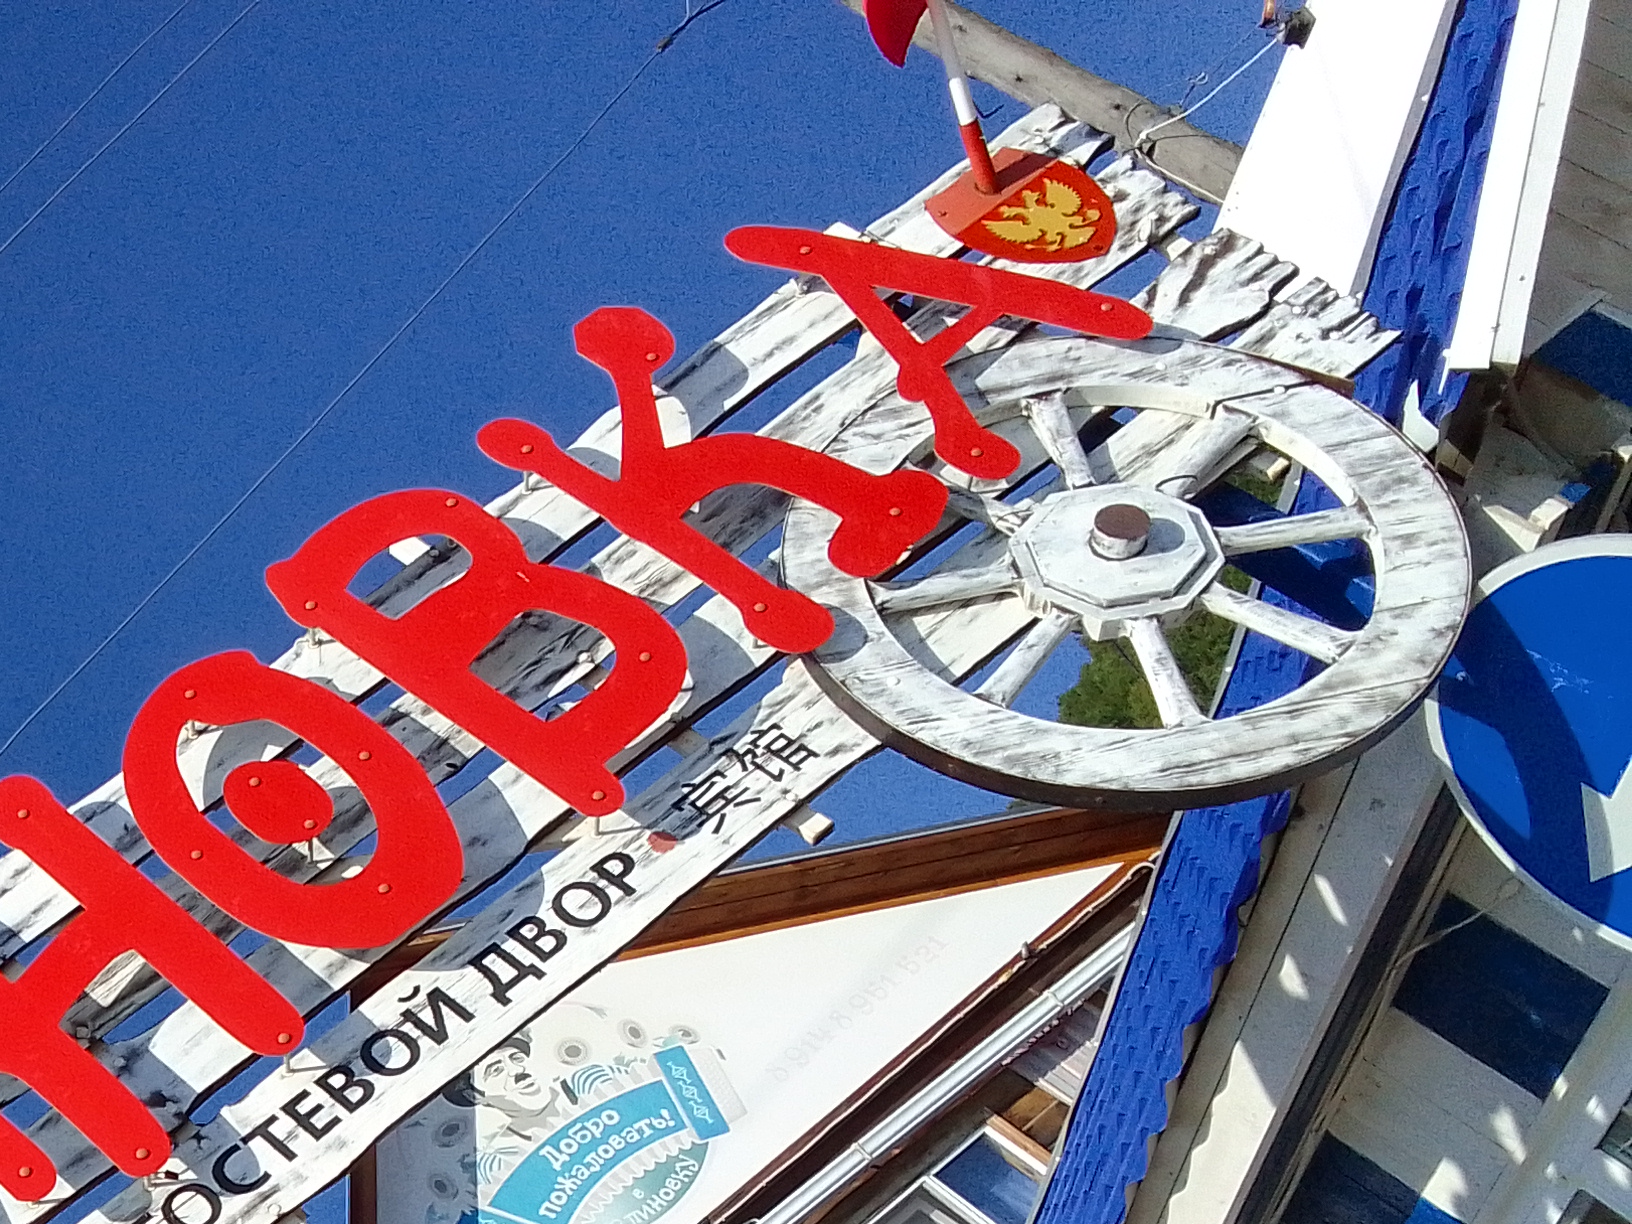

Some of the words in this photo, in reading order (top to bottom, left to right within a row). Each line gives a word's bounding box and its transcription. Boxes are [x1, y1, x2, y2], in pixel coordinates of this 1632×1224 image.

[671, 722, 820, 834] 宾馆
[470, 852, 638, 1006] ДВОР
[538, 1108, 676, 1219] пожаловать!
[539, 1109, 620, 1171] Добро
